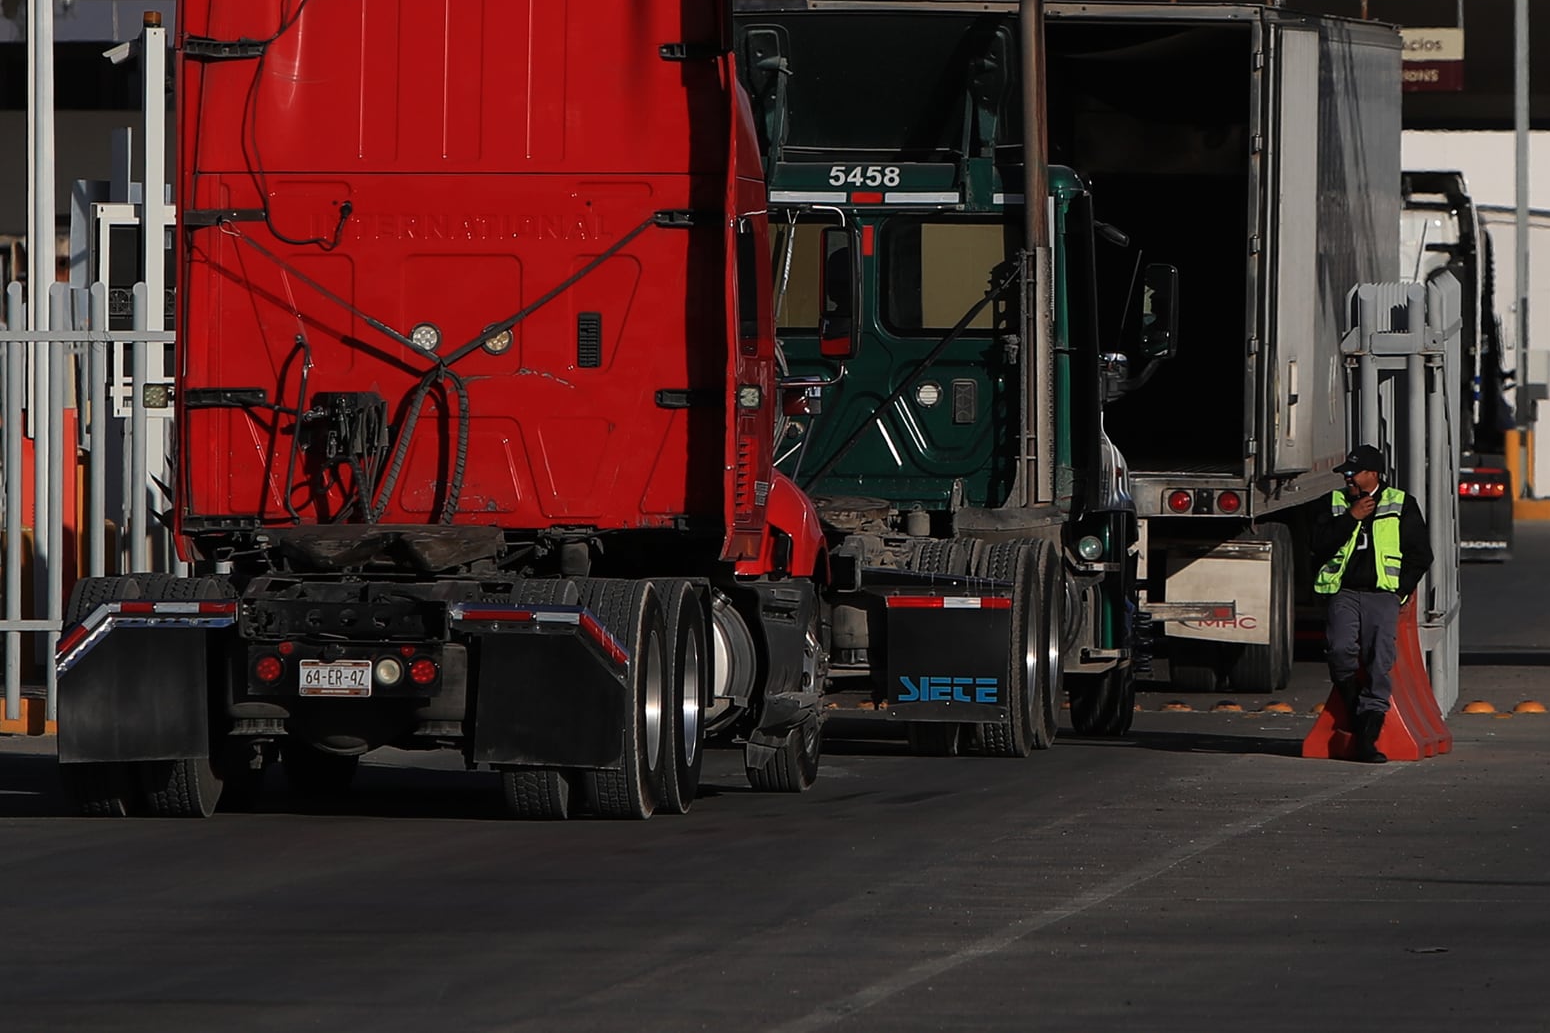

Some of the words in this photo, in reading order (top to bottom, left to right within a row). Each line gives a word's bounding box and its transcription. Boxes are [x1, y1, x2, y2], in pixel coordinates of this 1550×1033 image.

[829, 166, 900, 187] 5458
[310, 215, 614, 240] INTERNATIONAL
[898, 676, 998, 703] SIETE
